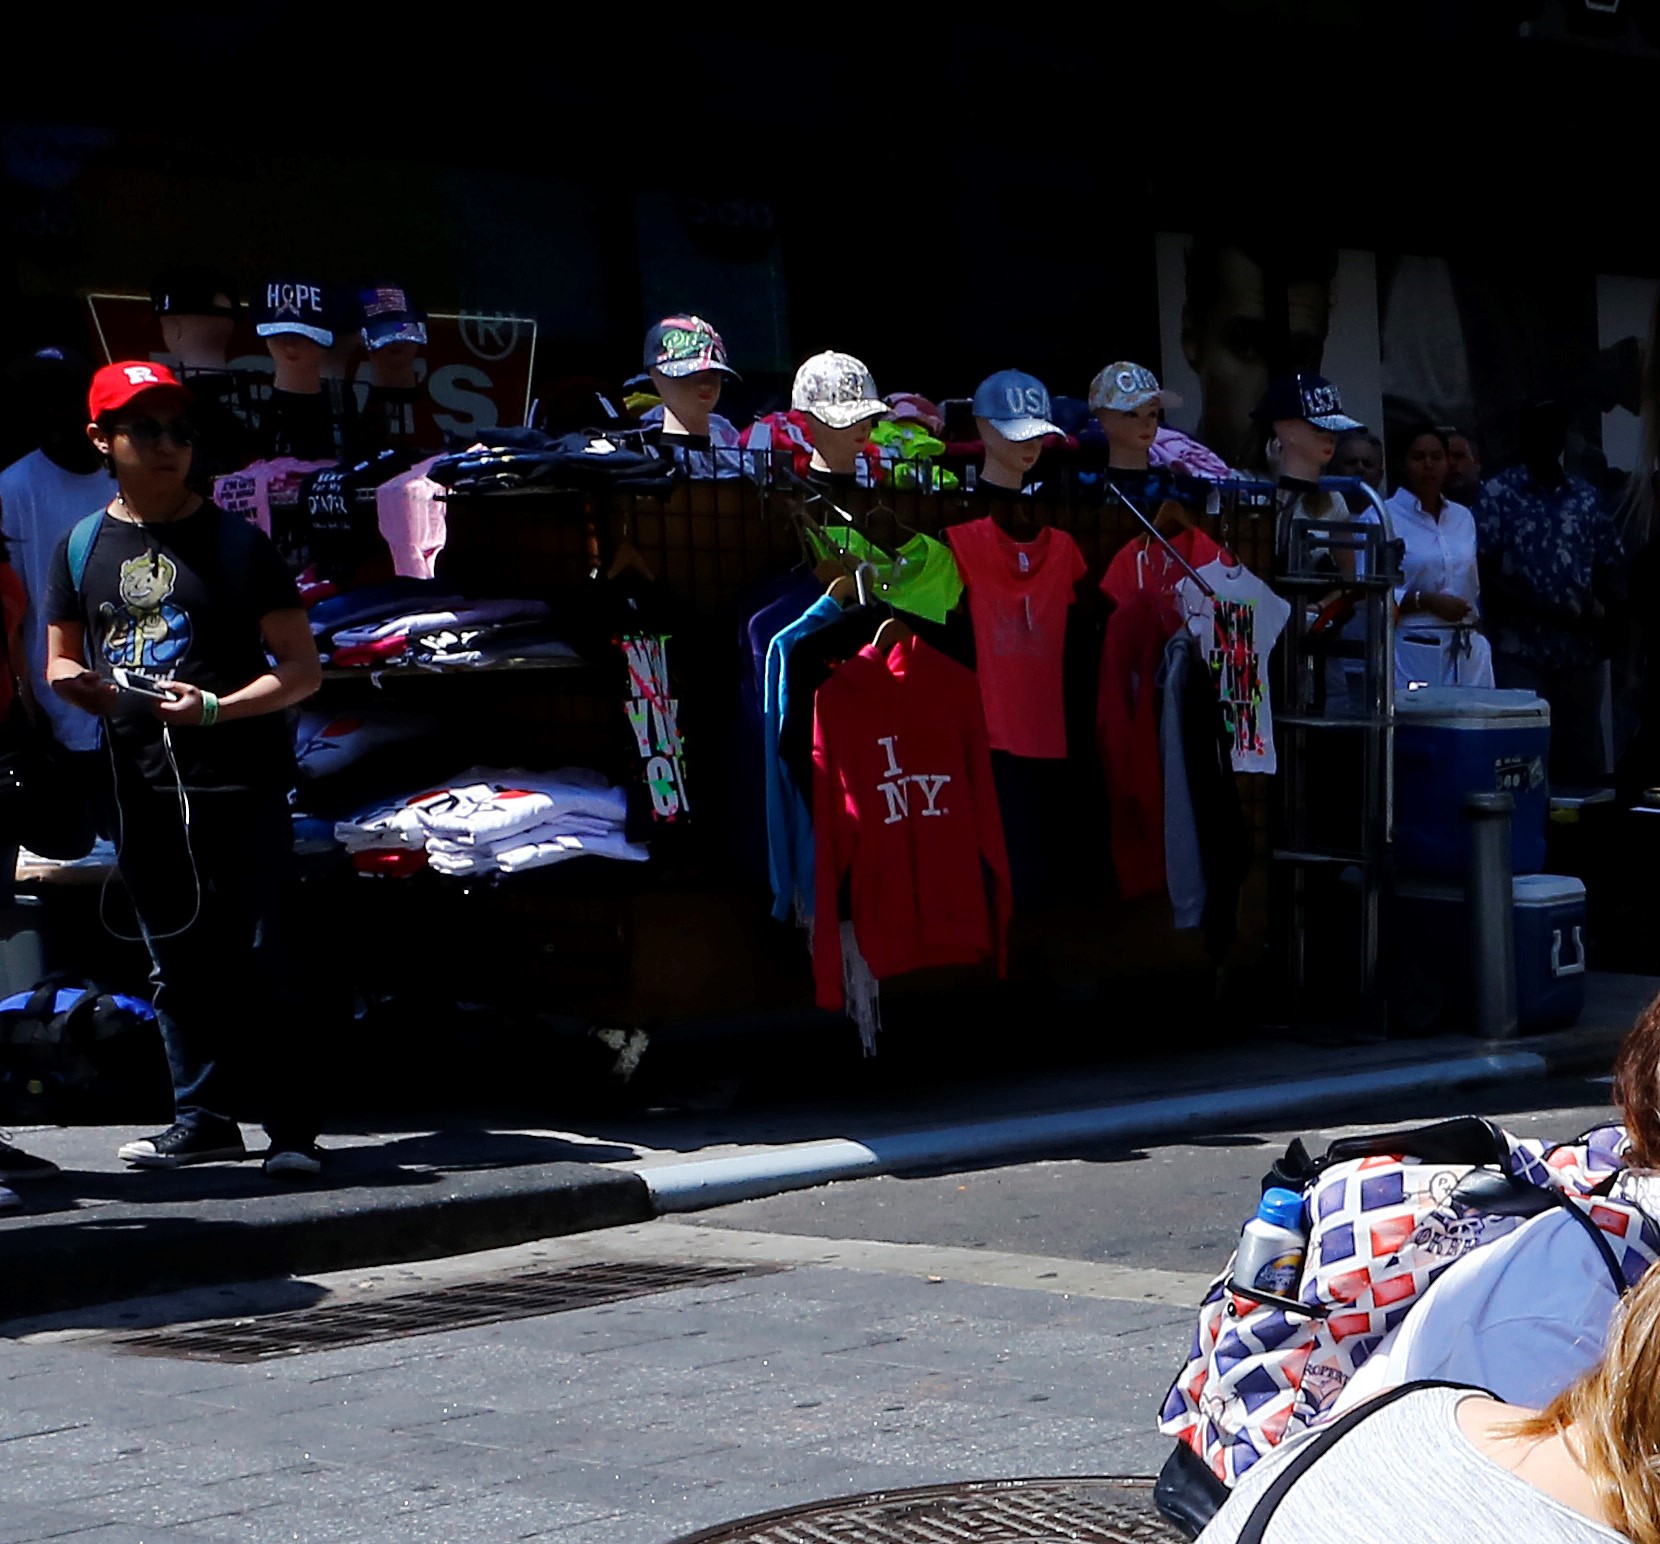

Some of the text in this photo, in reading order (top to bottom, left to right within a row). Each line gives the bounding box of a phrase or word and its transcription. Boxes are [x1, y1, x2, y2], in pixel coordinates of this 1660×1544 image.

[267, 283, 323, 313] HOPE
[123, 366, 159, 385] R
[878, 736, 903, 778] I
